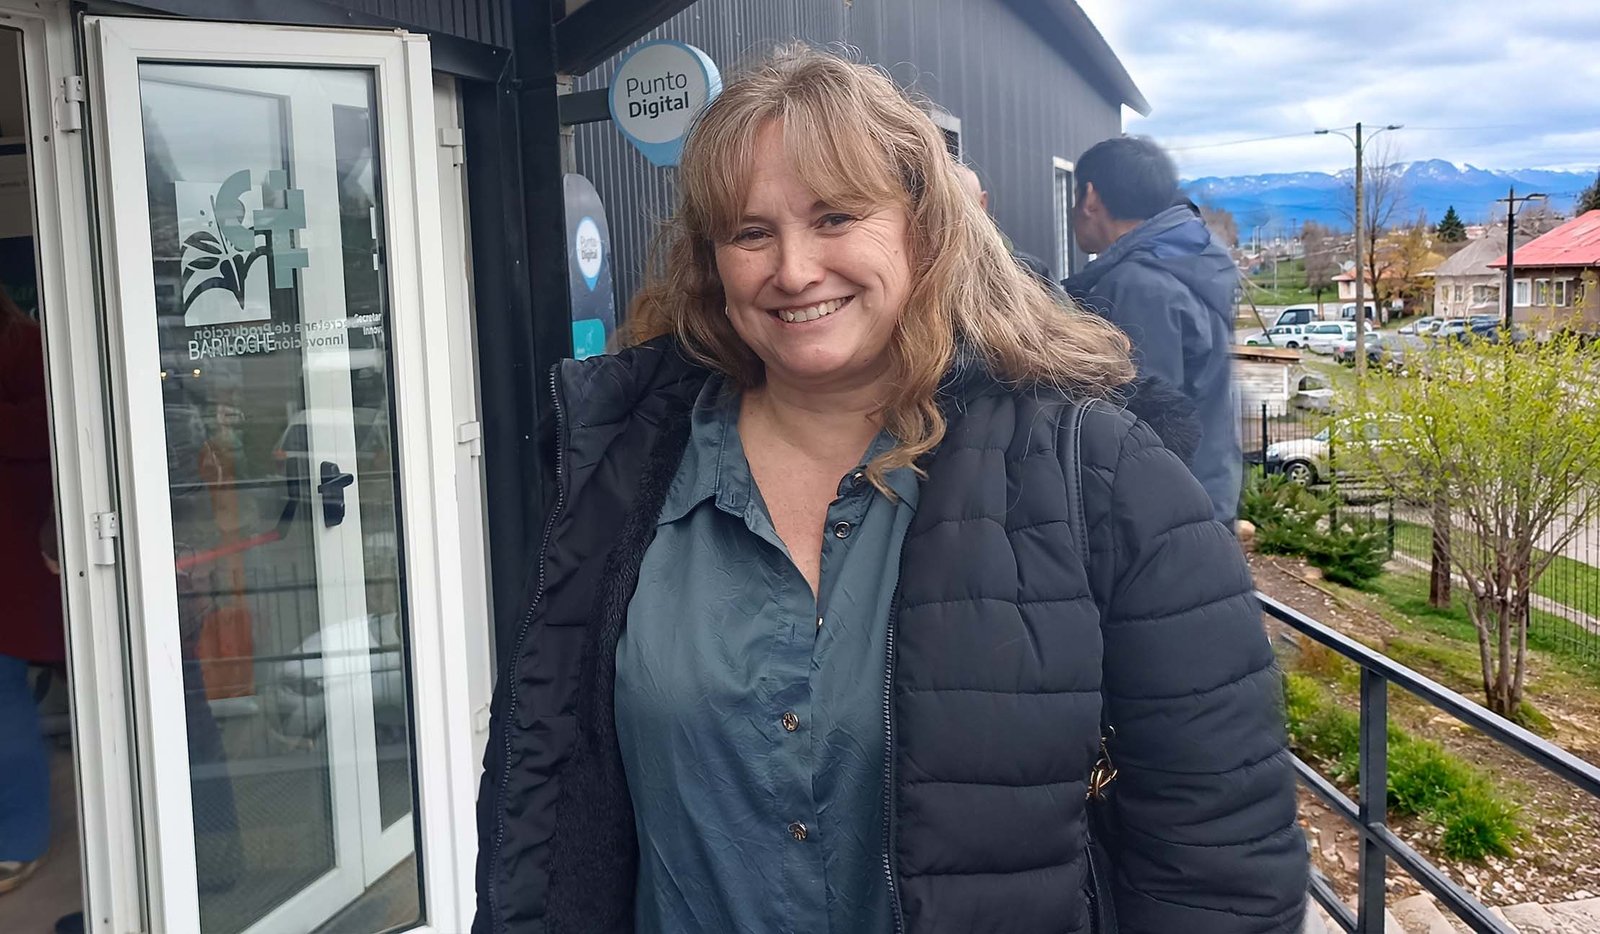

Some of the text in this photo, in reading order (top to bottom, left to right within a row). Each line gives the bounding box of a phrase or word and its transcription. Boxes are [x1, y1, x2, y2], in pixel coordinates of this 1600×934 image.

[626, 72, 687, 97] Punto
[629, 91, 689, 119] Digital
[582, 249, 597, 262] Digital
[188, 332, 275, 360] BARILOCHE
